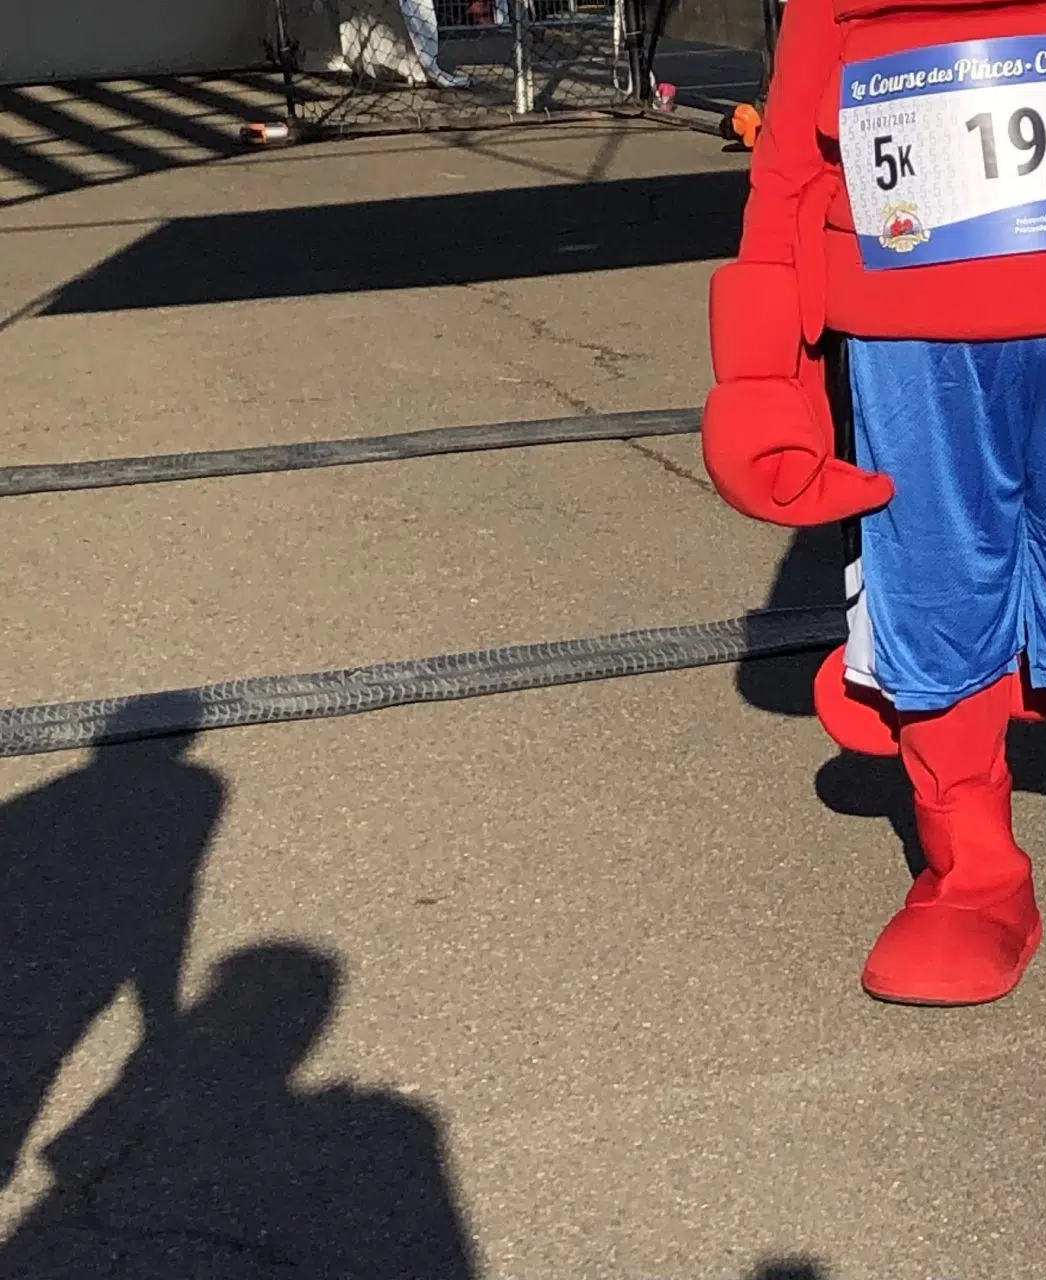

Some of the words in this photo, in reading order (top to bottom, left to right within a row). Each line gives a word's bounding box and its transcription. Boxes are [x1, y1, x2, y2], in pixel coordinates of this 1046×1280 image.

[851, 81, 866, 100] La
[869, 69, 927, 97] Course
[927, 67, 954, 84] des
[954, 57, 1024, 82] Pinces
